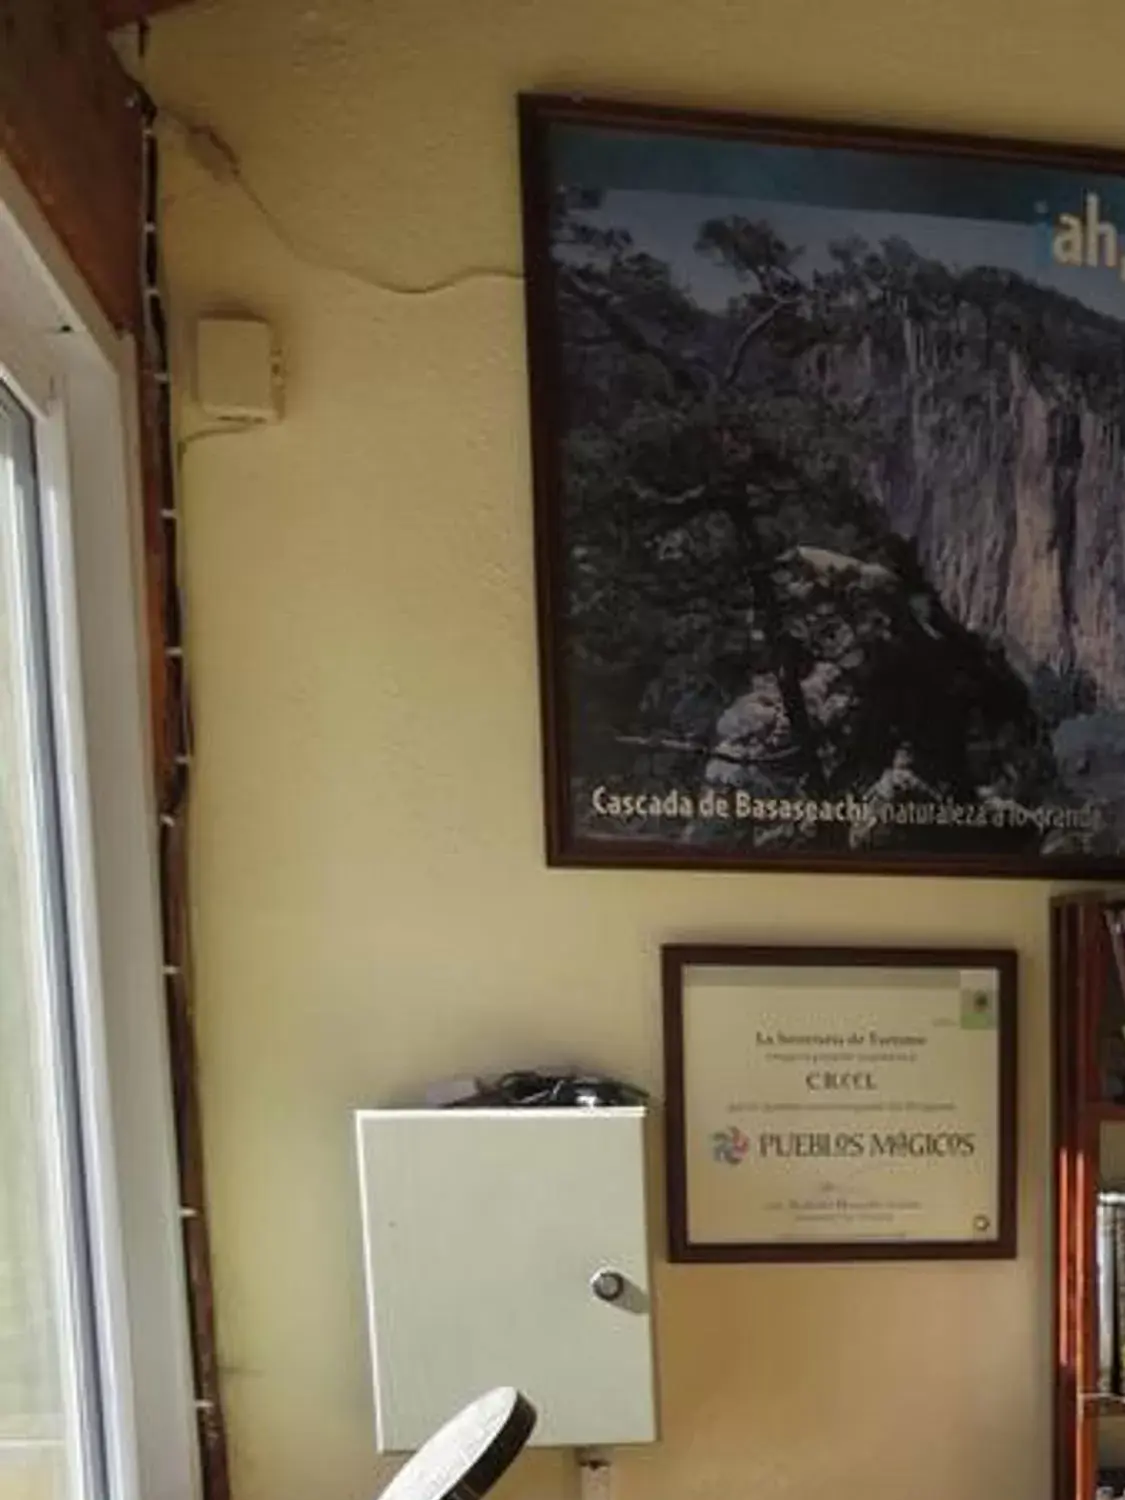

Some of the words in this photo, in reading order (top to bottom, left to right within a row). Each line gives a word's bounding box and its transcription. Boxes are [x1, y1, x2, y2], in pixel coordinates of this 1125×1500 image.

[592, 785, 694, 817] Cascada
[700, 789, 730, 819] de
[760, 1132, 864, 1158] PUEBLOS
